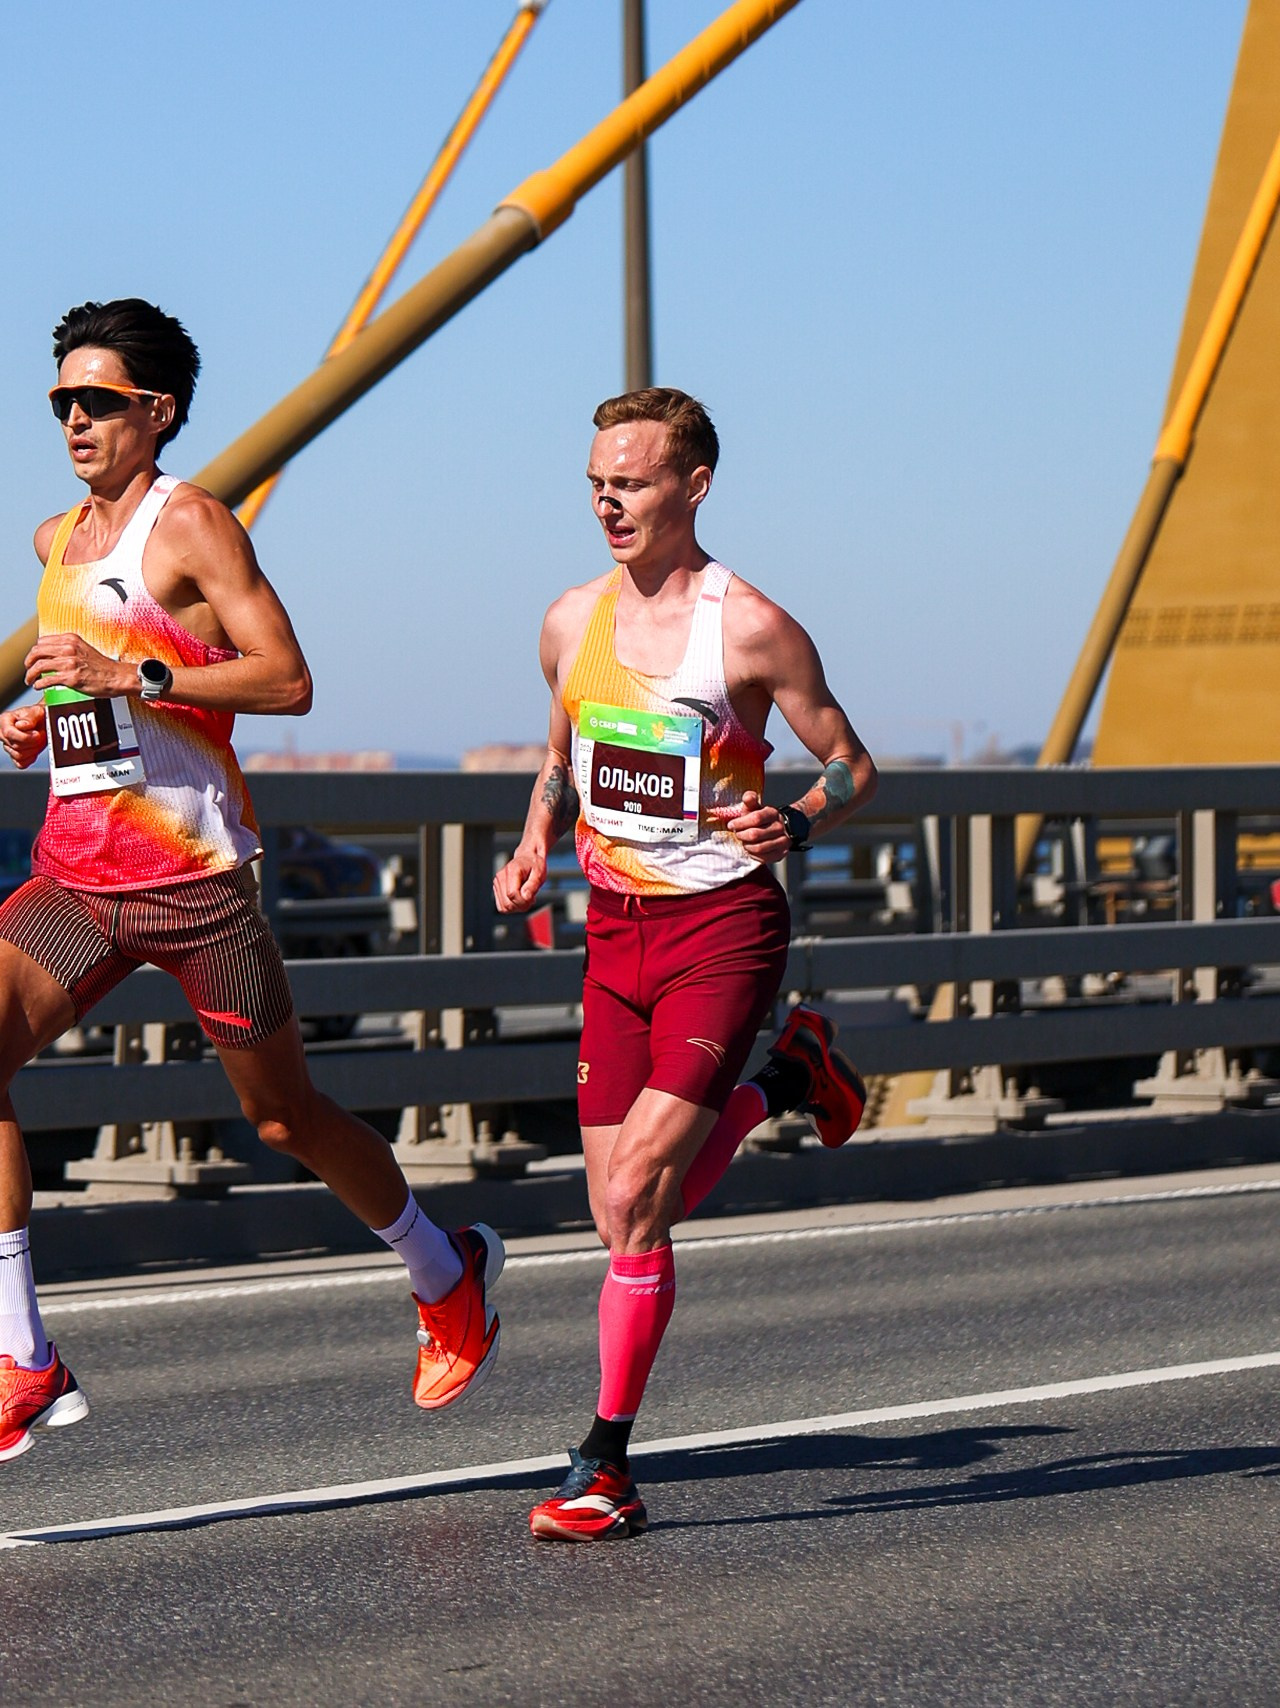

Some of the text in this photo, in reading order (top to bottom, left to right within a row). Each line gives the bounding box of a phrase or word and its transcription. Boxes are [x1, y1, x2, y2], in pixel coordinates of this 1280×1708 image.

[57, 712, 100, 751] 9011
[599, 766, 674, 798] ОЛЬКОВ
[623, 801, 642, 813] 9010
